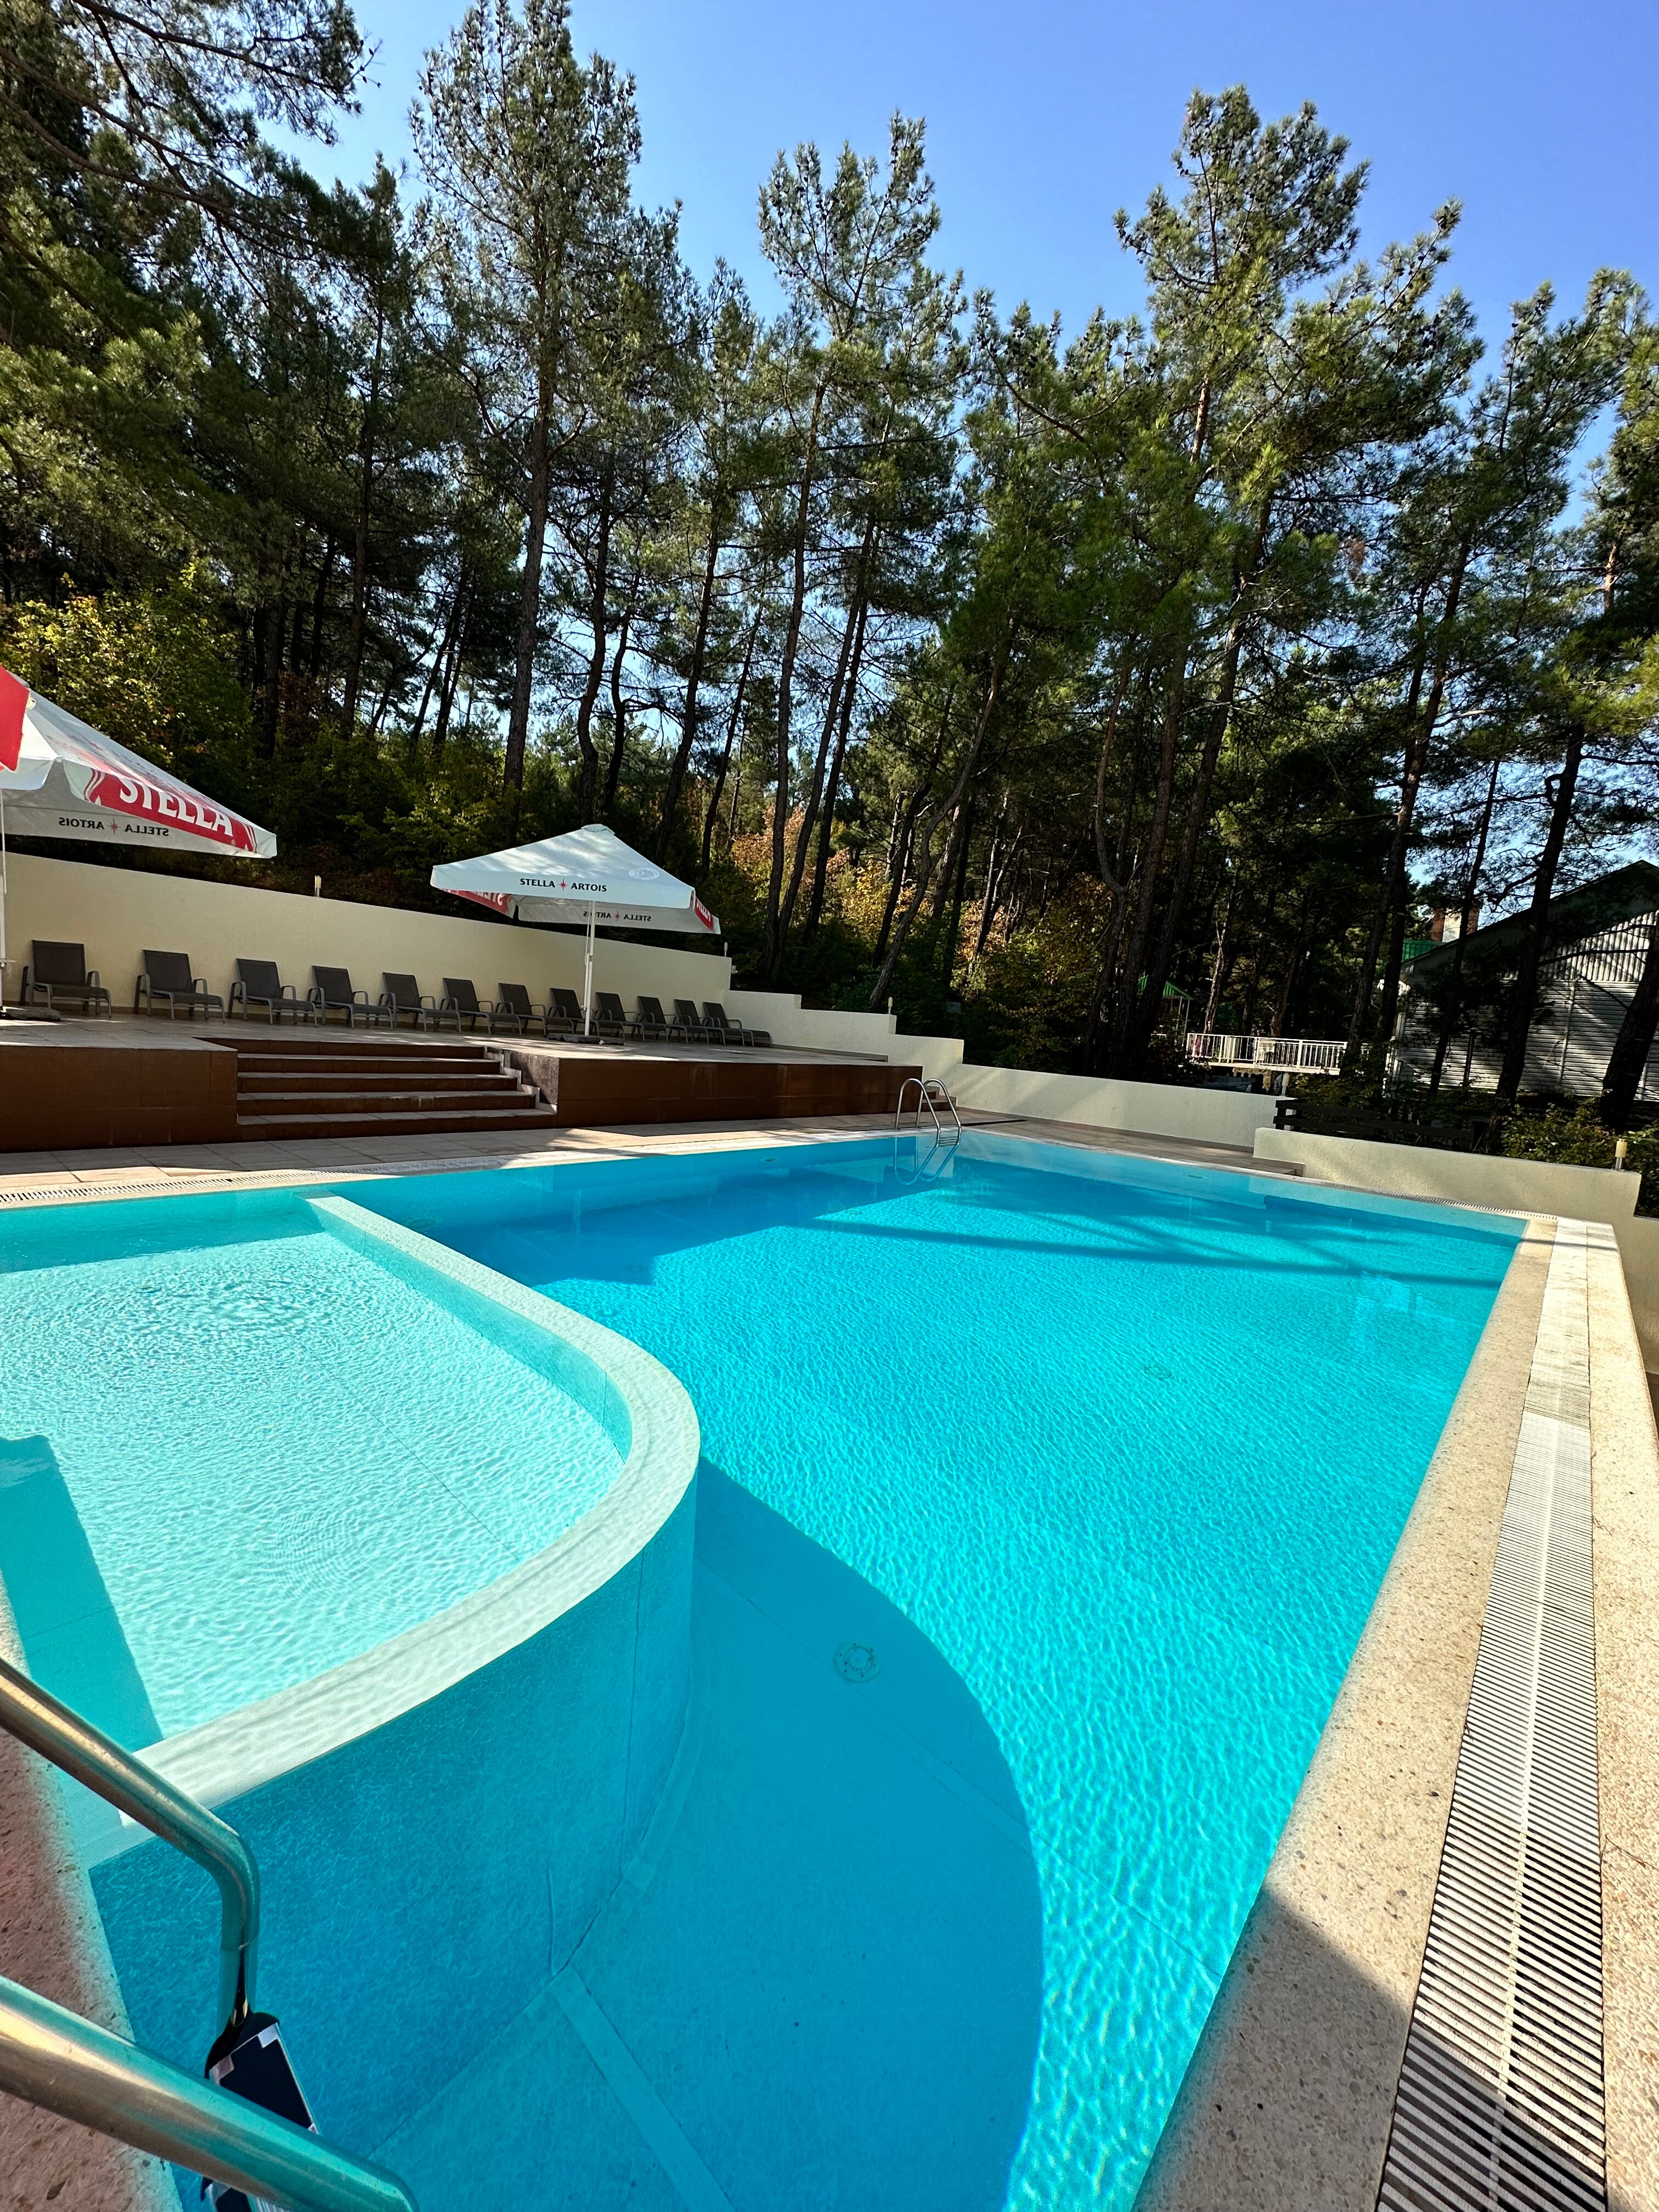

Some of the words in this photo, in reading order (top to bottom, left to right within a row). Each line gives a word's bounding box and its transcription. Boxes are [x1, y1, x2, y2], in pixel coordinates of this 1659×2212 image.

[120, 777, 233, 837] STELLA
[520, 878, 555, 888] STELLA
[571, 883, 607, 892] ARTOIS
